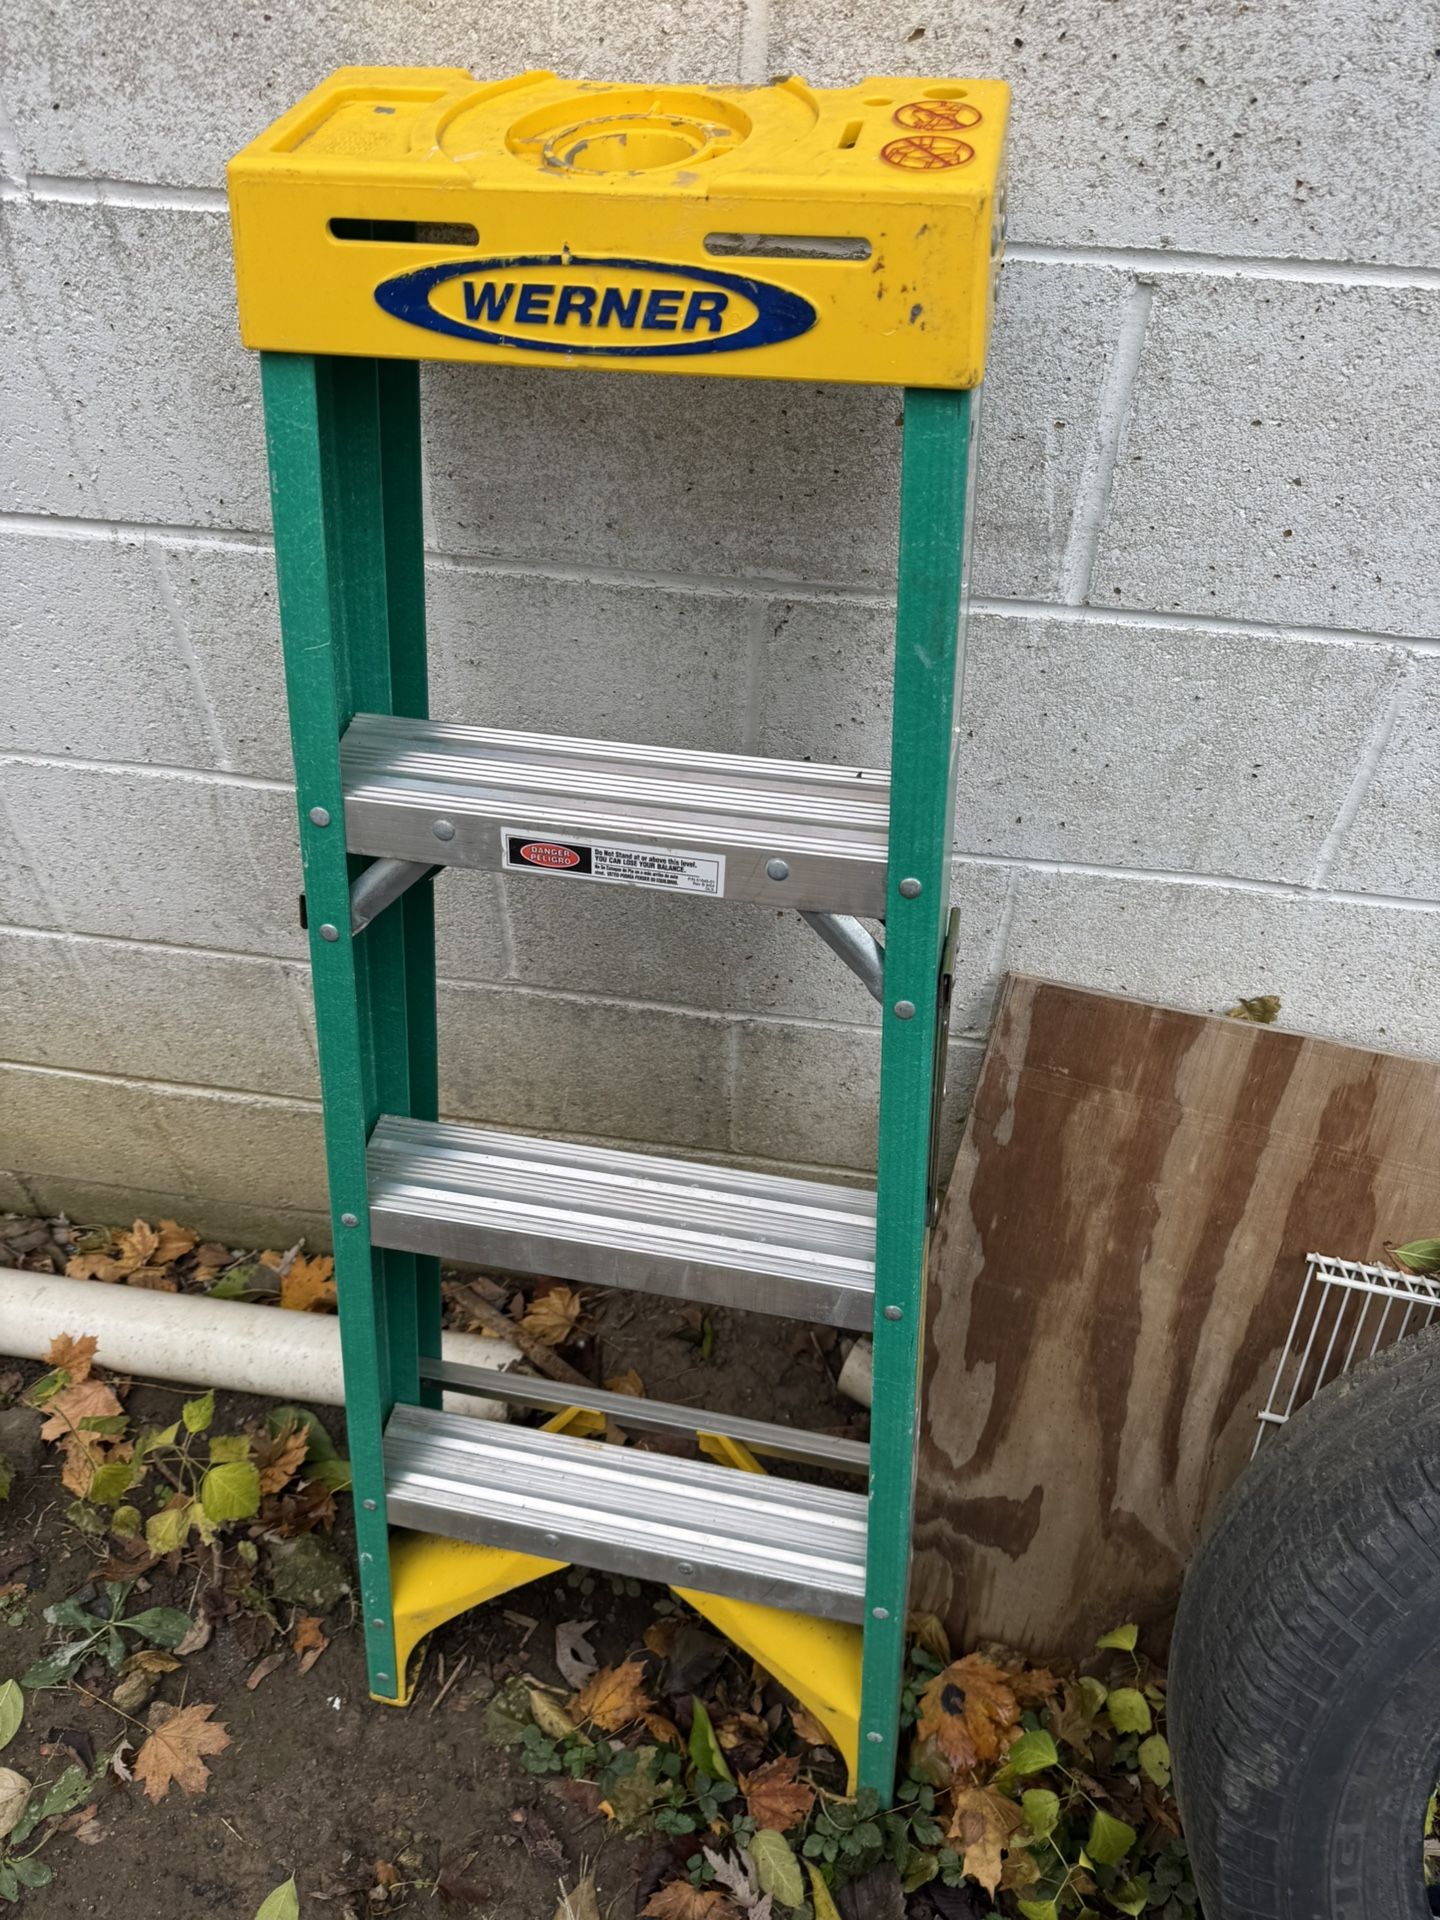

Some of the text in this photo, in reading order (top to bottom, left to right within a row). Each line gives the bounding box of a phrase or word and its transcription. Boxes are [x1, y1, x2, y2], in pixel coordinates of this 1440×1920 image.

[462, 281, 729, 332] WERNER
[531, 846, 570, 857] DANGER
[530, 854, 571, 865] PELIGRO
[615, 851, 632, 859] Stand
[649, 856, 666, 864] above
[680, 859, 697, 868] level.
[623, 859, 637, 867] LOSE
[639, 861, 655, 869] YOUR
[657, 863, 686, 873] BALANCE.
